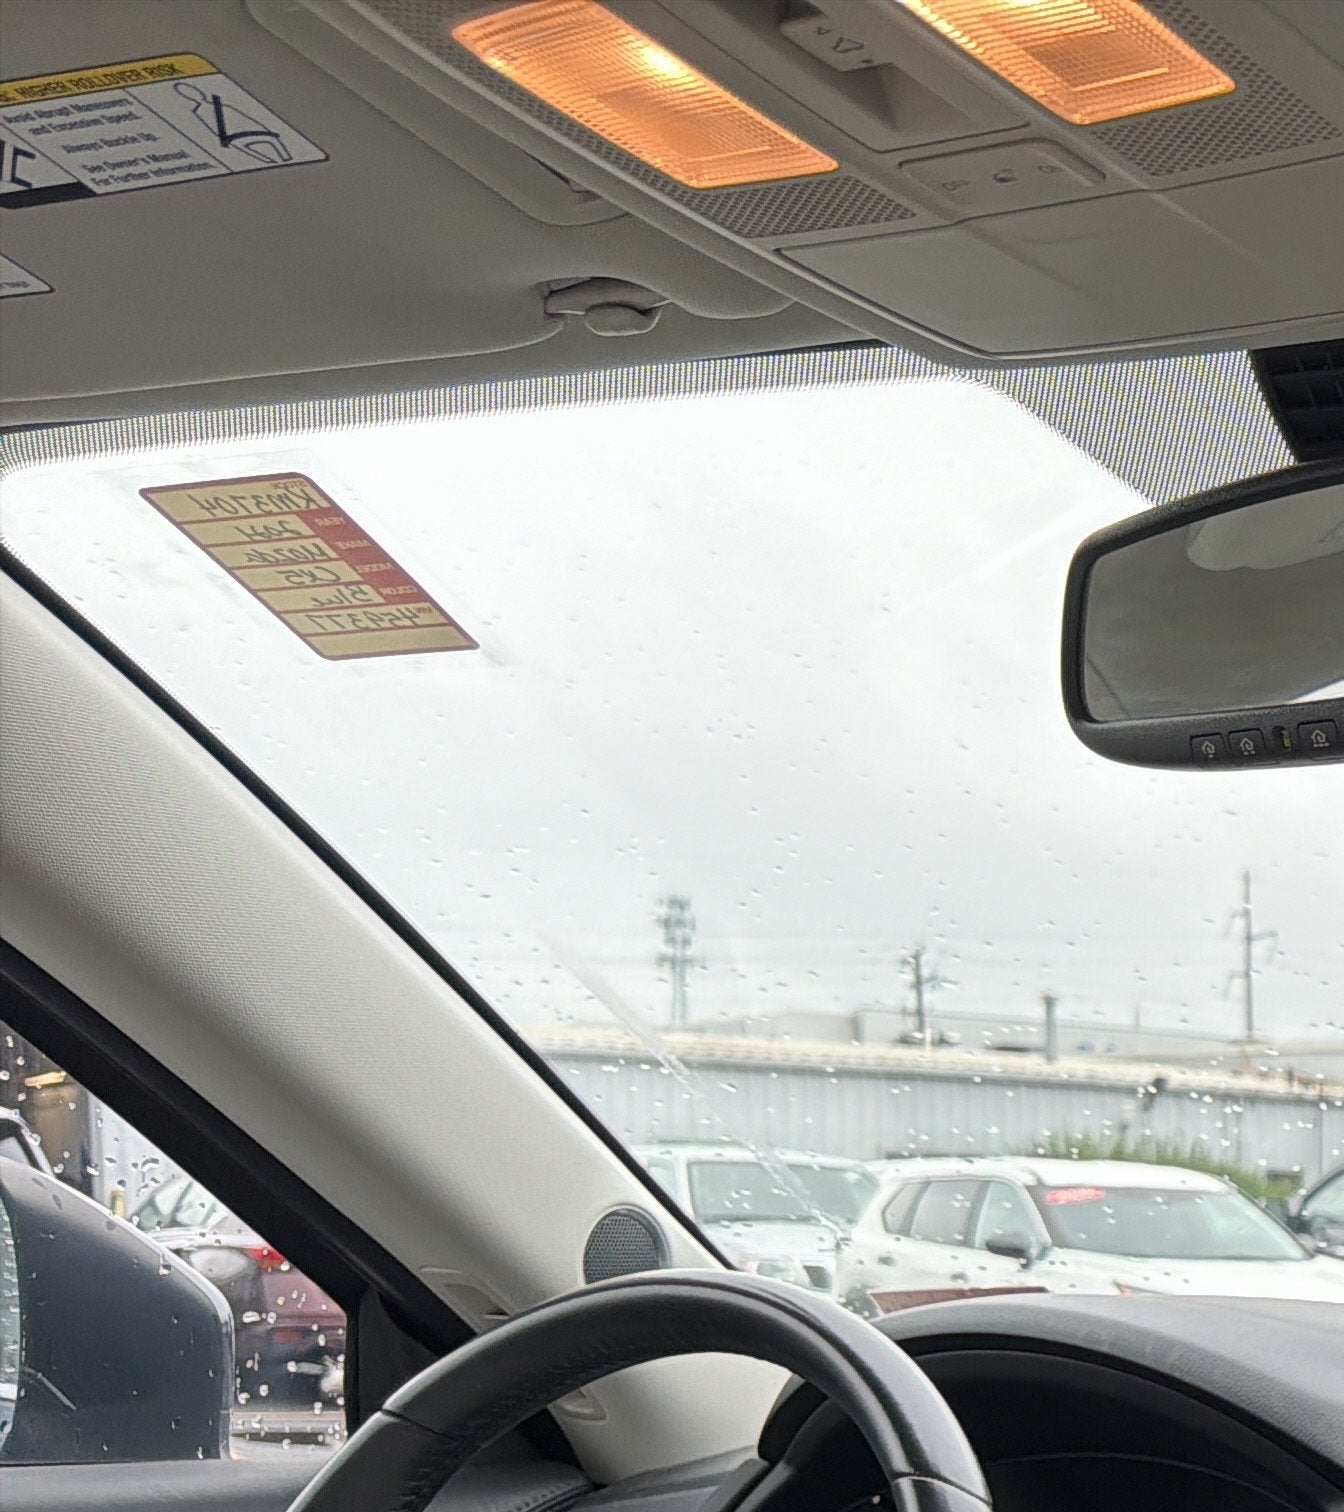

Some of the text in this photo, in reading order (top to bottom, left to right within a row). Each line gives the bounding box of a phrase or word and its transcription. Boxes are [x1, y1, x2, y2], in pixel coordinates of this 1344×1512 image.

[15, 82, 66, 98] HIGHER
[71, 70, 142, 90] ROLLOVER
[147, 63, 185, 78] RISK
